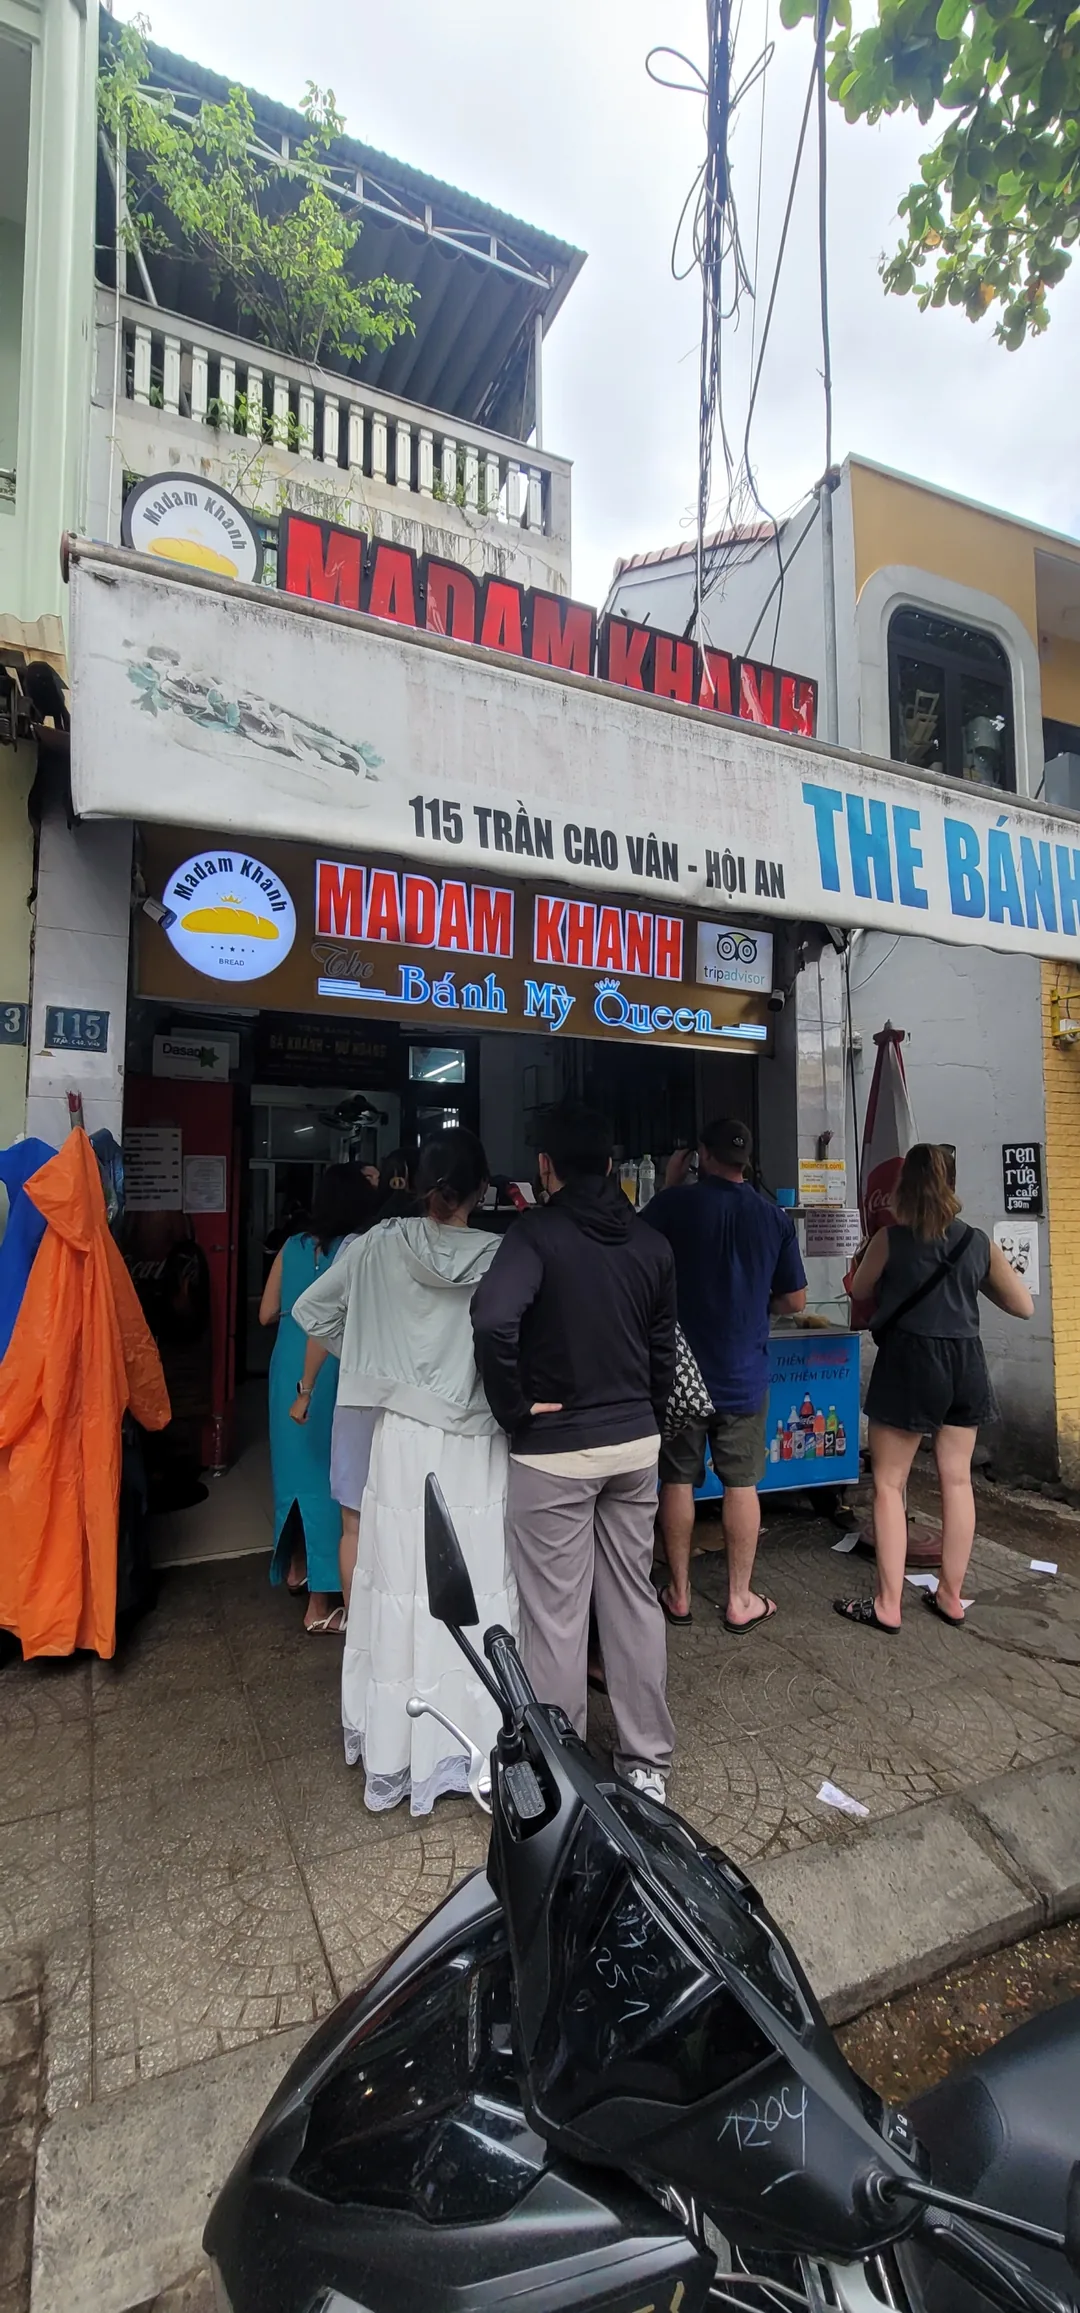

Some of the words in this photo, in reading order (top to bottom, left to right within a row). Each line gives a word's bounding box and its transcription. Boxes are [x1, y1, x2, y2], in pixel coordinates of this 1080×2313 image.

[143, 489, 199, 527] Madam
[203, 496, 248, 551] Khanh
[286, 516, 593, 676] MADAM
[609, 621, 815, 738] KHANH
[409, 795, 463, 844] 115
[473, 800, 554, 860] TRẦN
[563, 823, 618, 871] CAO
[626, 832, 679, 882] VÂN
[705, 847, 746, 899] HỘI
[755, 859, 786, 899] AN
[802, 782, 929, 909] THE
[944, 815, 1080, 936] BÁNH
[173, 857, 233, 901] Madam
[315, 859, 514, 959] MADAM
[533, 894, 684, 982] KHANH
[218, 958, 245, 967] BREAD
[311, 942, 375, 979] The
[703, 965, 765, 985] tripadvisor
[398, 964, 508, 1014] Bánh
[524, 979, 576, 1032] Mỳ
[593, 990, 714, 1034] Queen
[53, 1011, 101, 1040] 115
[1005, 1147, 1036, 1164] ren
[1006, 1164, 1037, 1185] rứa
[1016, 1184, 1039, 1197] café
[1013, 1201, 1030, 1209] 30m
